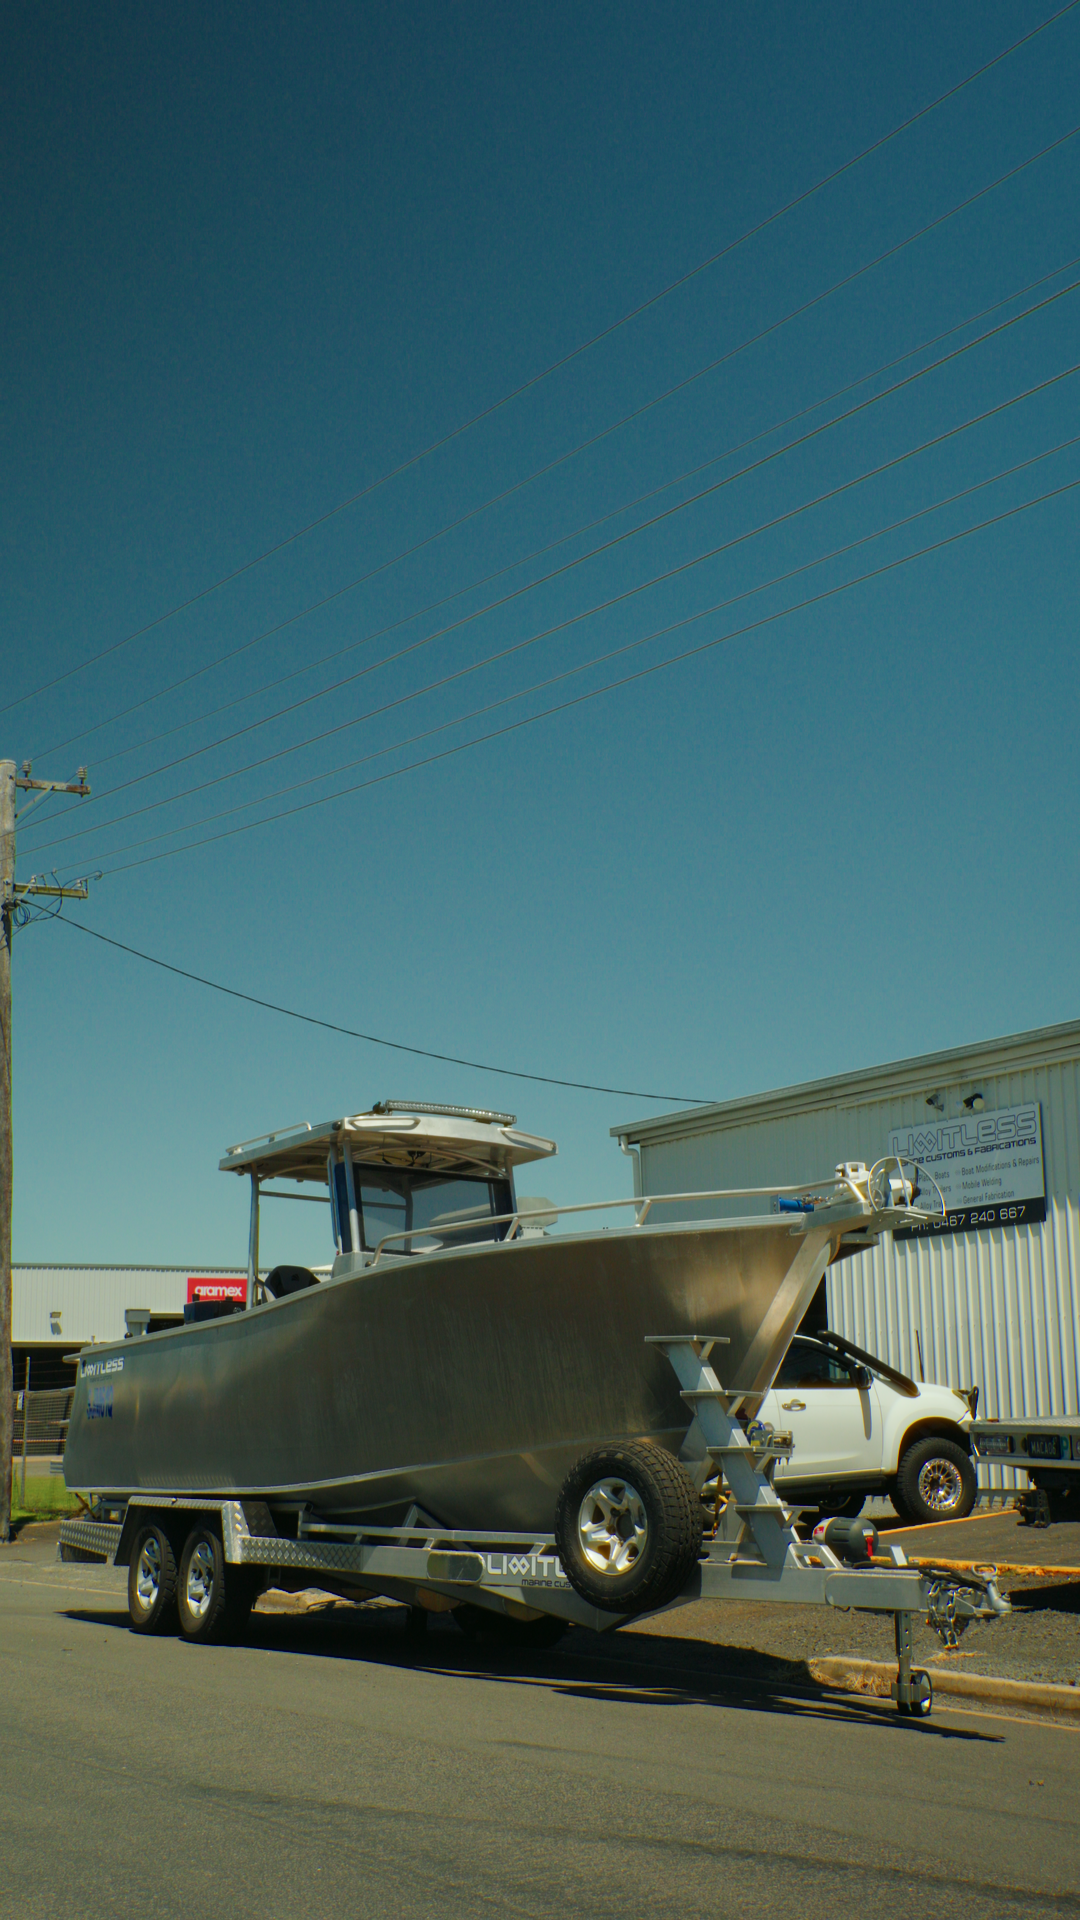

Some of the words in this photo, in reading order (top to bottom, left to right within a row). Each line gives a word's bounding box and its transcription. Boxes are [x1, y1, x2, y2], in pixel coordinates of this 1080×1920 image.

[925, 1149, 965, 1163] CUSTOMS
[967, 1148, 973, 1156] &
[975, 1137, 1036, 1154] FABRICATIONS
[961, 1167, 974, 1176] Boat
[975, 1161, 1011, 1174] Modifications
[1012, 1158, 1017, 1167] &
[1018, 1156, 1040, 1167] Repairs
[934, 1171, 950, 1180] Boats
[962, 1179, 980, 1189] Mobile
[981, 1177, 1002, 1187] Welding
[963, 1193, 983, 1204] General
[984, 1190, 1014, 1201] Fabrication
[970, 1210, 996, 1224] 240
[999, 1205, 1026, 1220] 667
[195, 1286, 242, 1297] aramex
